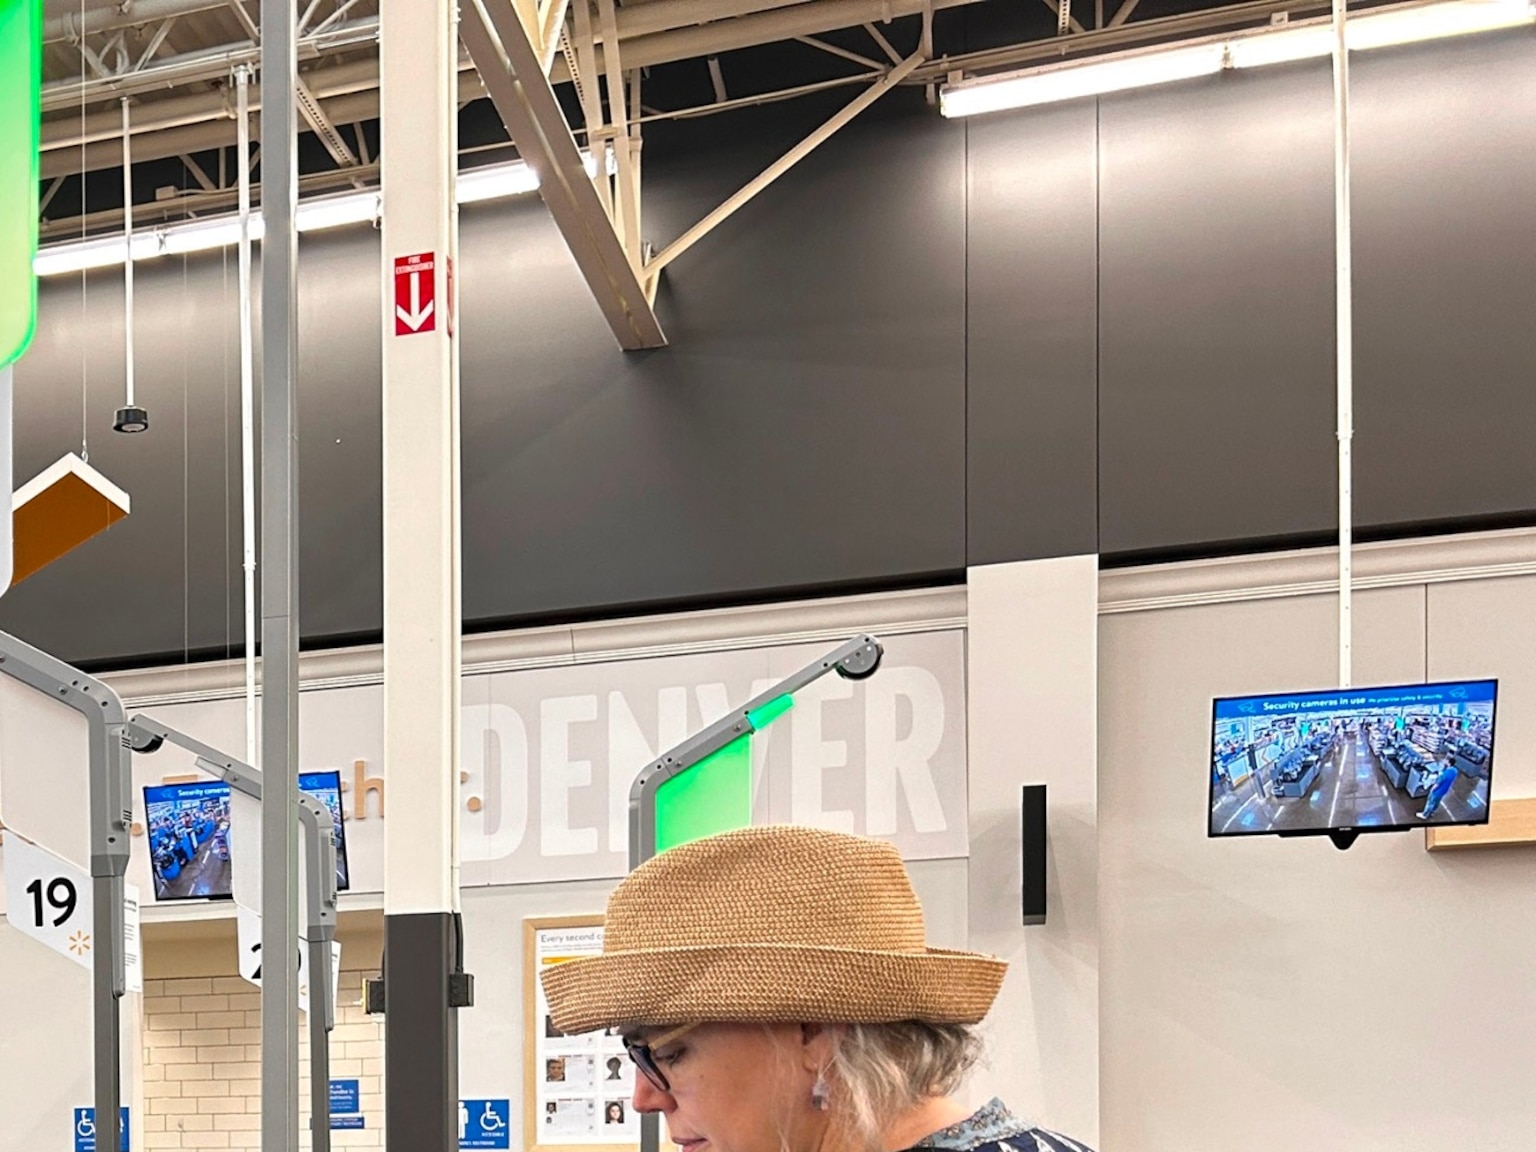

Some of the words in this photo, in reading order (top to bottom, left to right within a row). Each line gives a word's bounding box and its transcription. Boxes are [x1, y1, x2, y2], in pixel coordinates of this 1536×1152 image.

[1262, 700, 1300, 711] Security
[1301, 697, 1339, 709] cameras
[1339, 696, 1349, 705] in
[1350, 697, 1366, 705] use
[177, 789, 204, 797] Security
[25, 877, 77, 928] 19
[541, 934, 564, 943] Every
[566, 932, 595, 942] second
